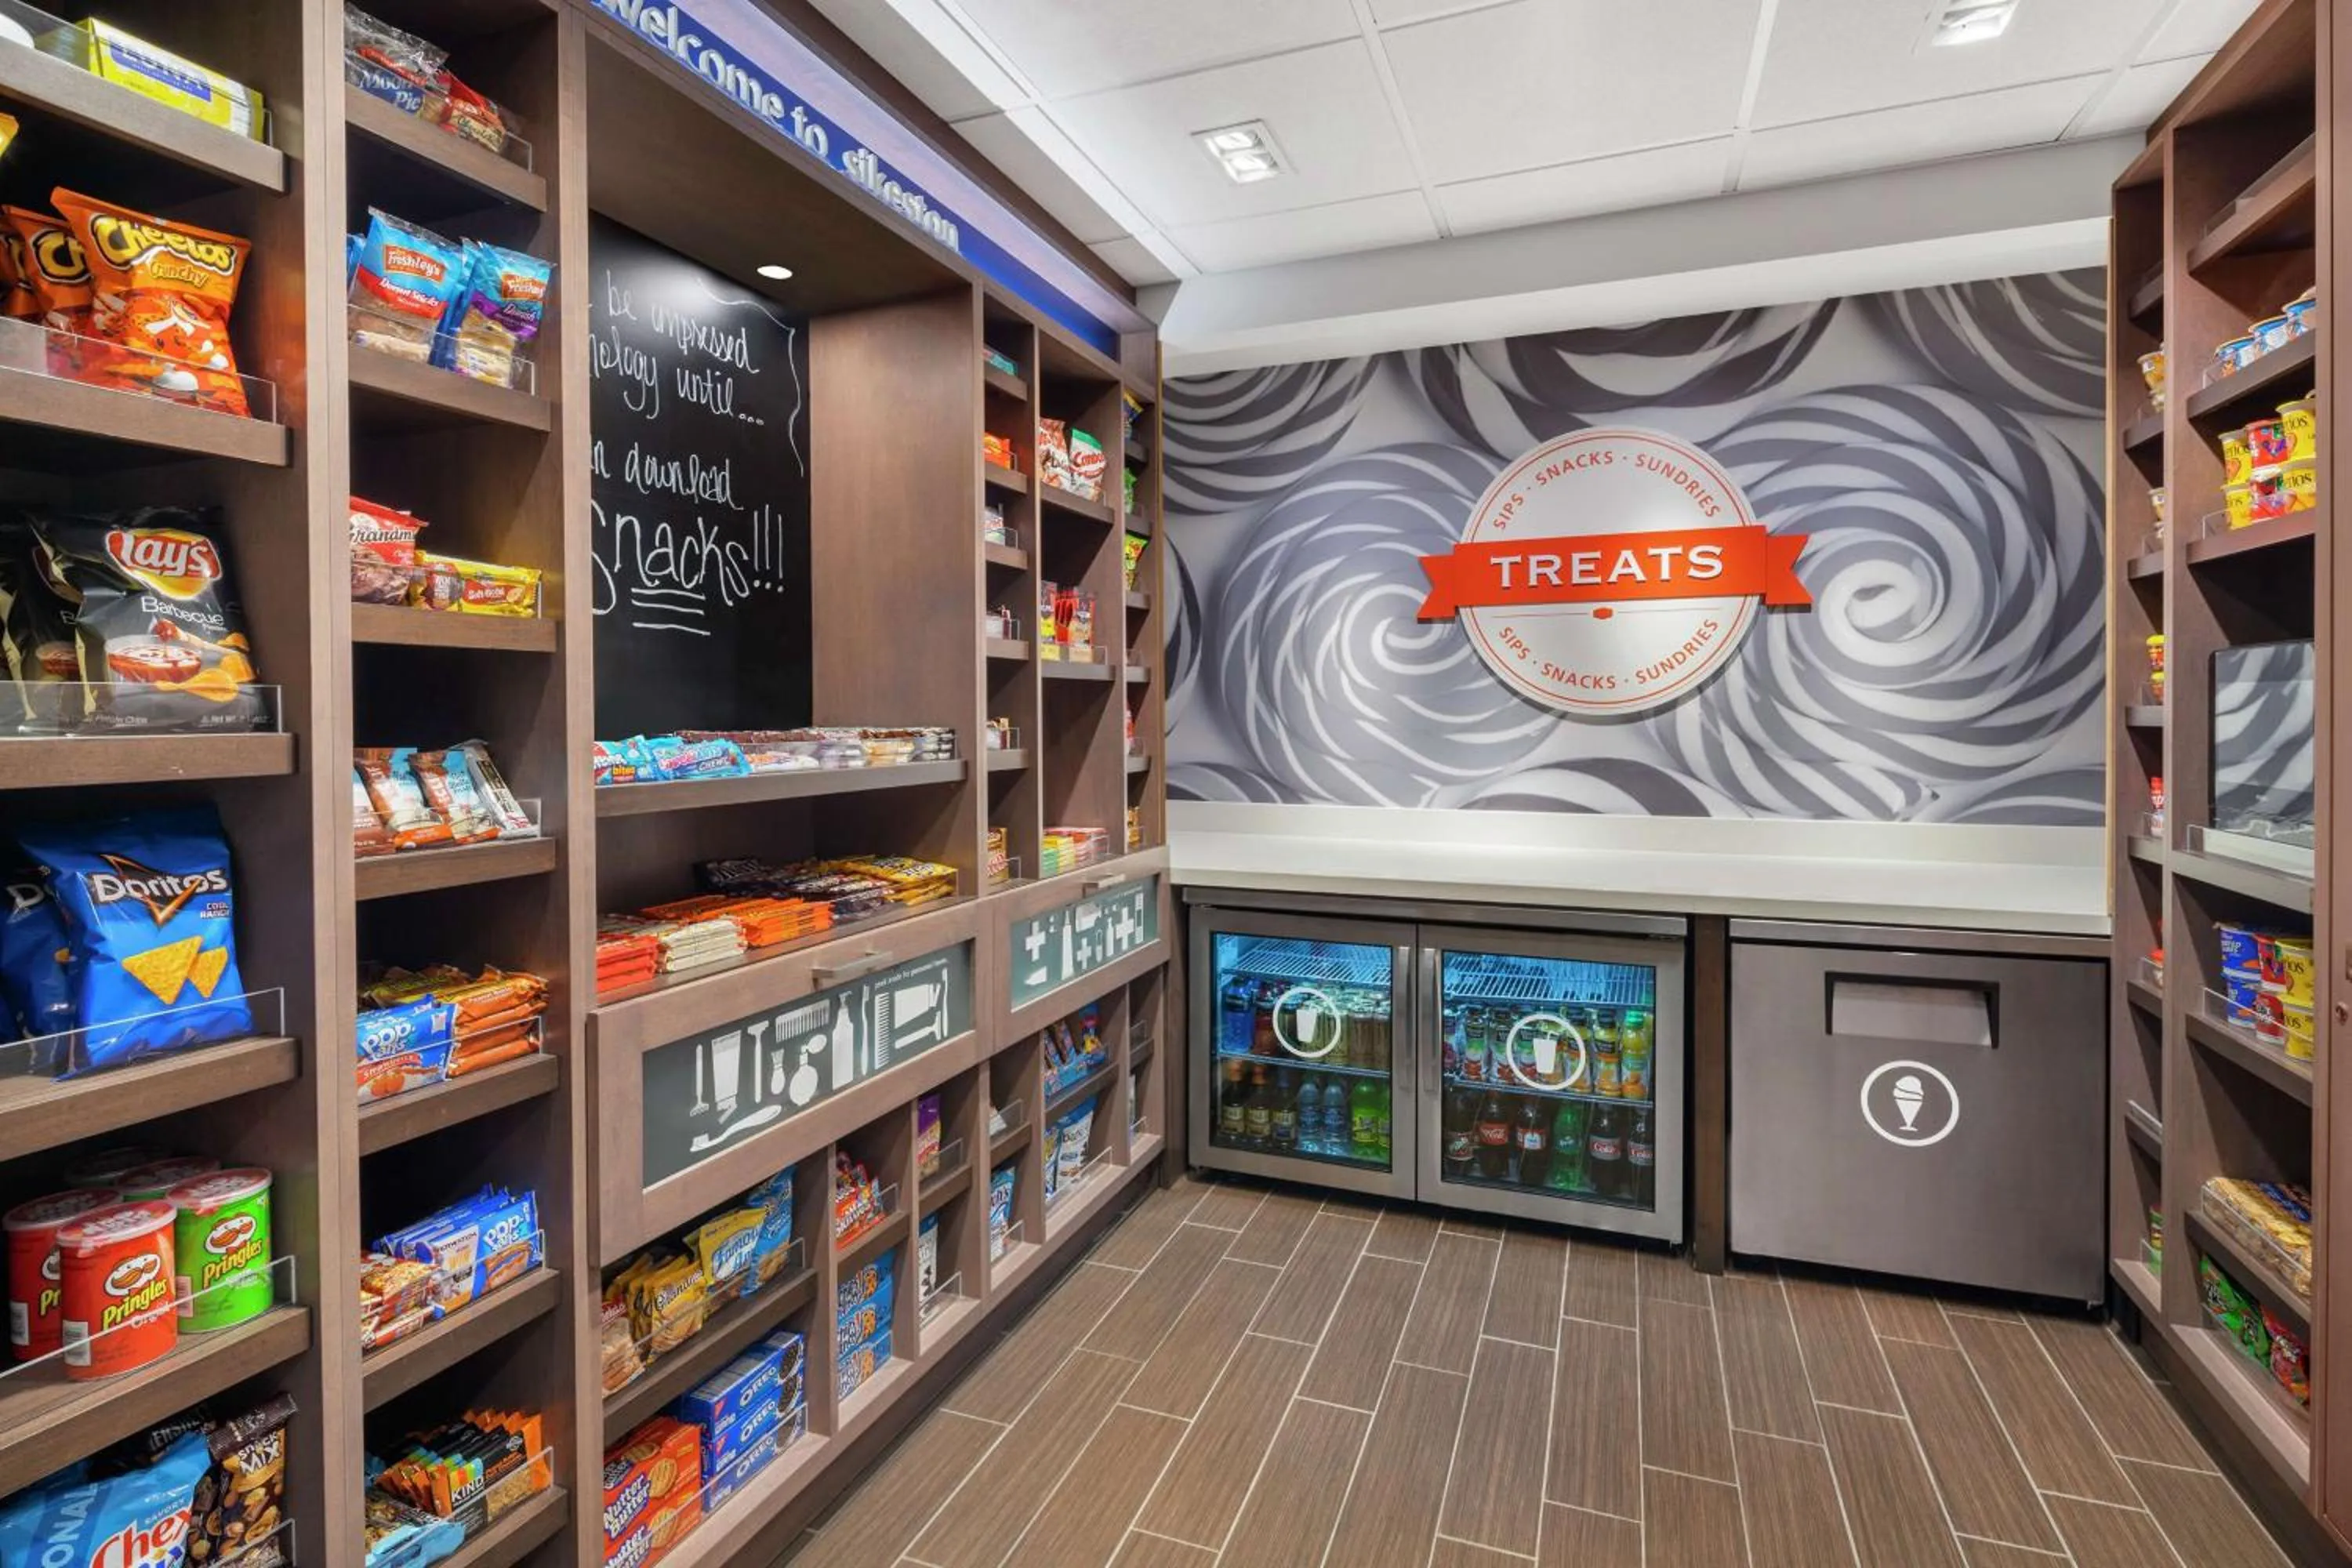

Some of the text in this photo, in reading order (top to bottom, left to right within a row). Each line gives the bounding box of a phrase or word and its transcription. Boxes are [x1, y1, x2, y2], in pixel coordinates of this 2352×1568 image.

[790, 106, 829, 157] to
[841, 148, 959, 252] sikeston
[94, 216, 234, 271] Cheetos
[150, 261, 209, 288] Crunchy
[605, 269, 637, 321] be
[1494, 450, 1722, 531] SIPS SNACKS SUNDRIES
[121, 532, 210, 576] Lay's
[1490, 544, 1724, 588] TREATS
[141, 596, 225, 626] Barbecue
[1498, 619, 1719, 690] SIPS SNACKS SUNDRIES
[92, 869, 228, 903] Doritos
[203, 1239, 263, 1289] Pringles
[102, 1279, 168, 1331] Pringles
[739, 1366, 778, 1409] OREO
[739, 1400, 776, 1443] OREO
[735, 1434, 775, 1479] OREO
[451, 1476, 485, 1502] KIND
[89, 1509, 192, 1568] Chex
